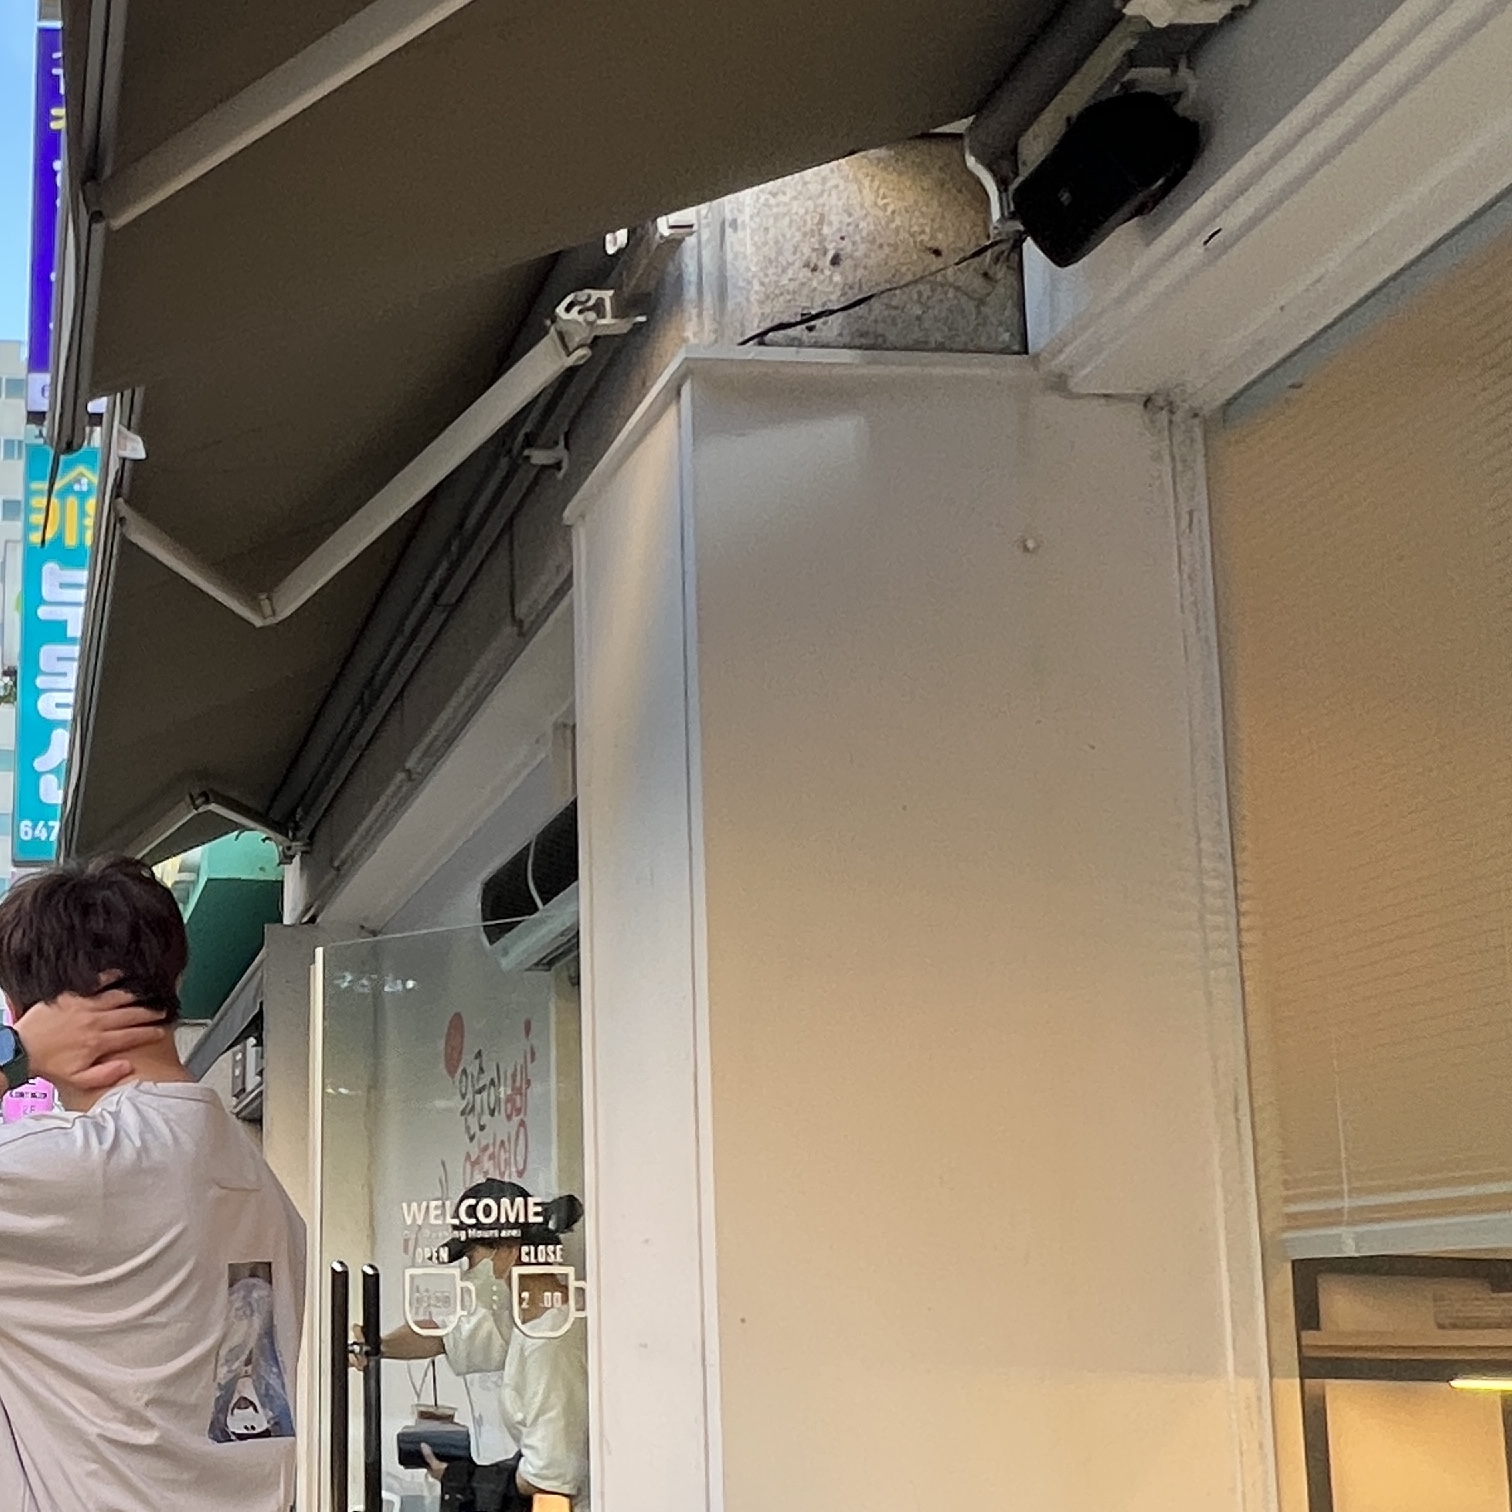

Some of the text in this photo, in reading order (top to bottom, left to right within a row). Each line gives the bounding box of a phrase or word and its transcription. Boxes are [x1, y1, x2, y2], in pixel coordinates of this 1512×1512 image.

[402, 1196, 544, 1225] WELCOME
[415, 1246, 450, 1264] OPEN
[520, 1245, 564, 1263] CLOSE
